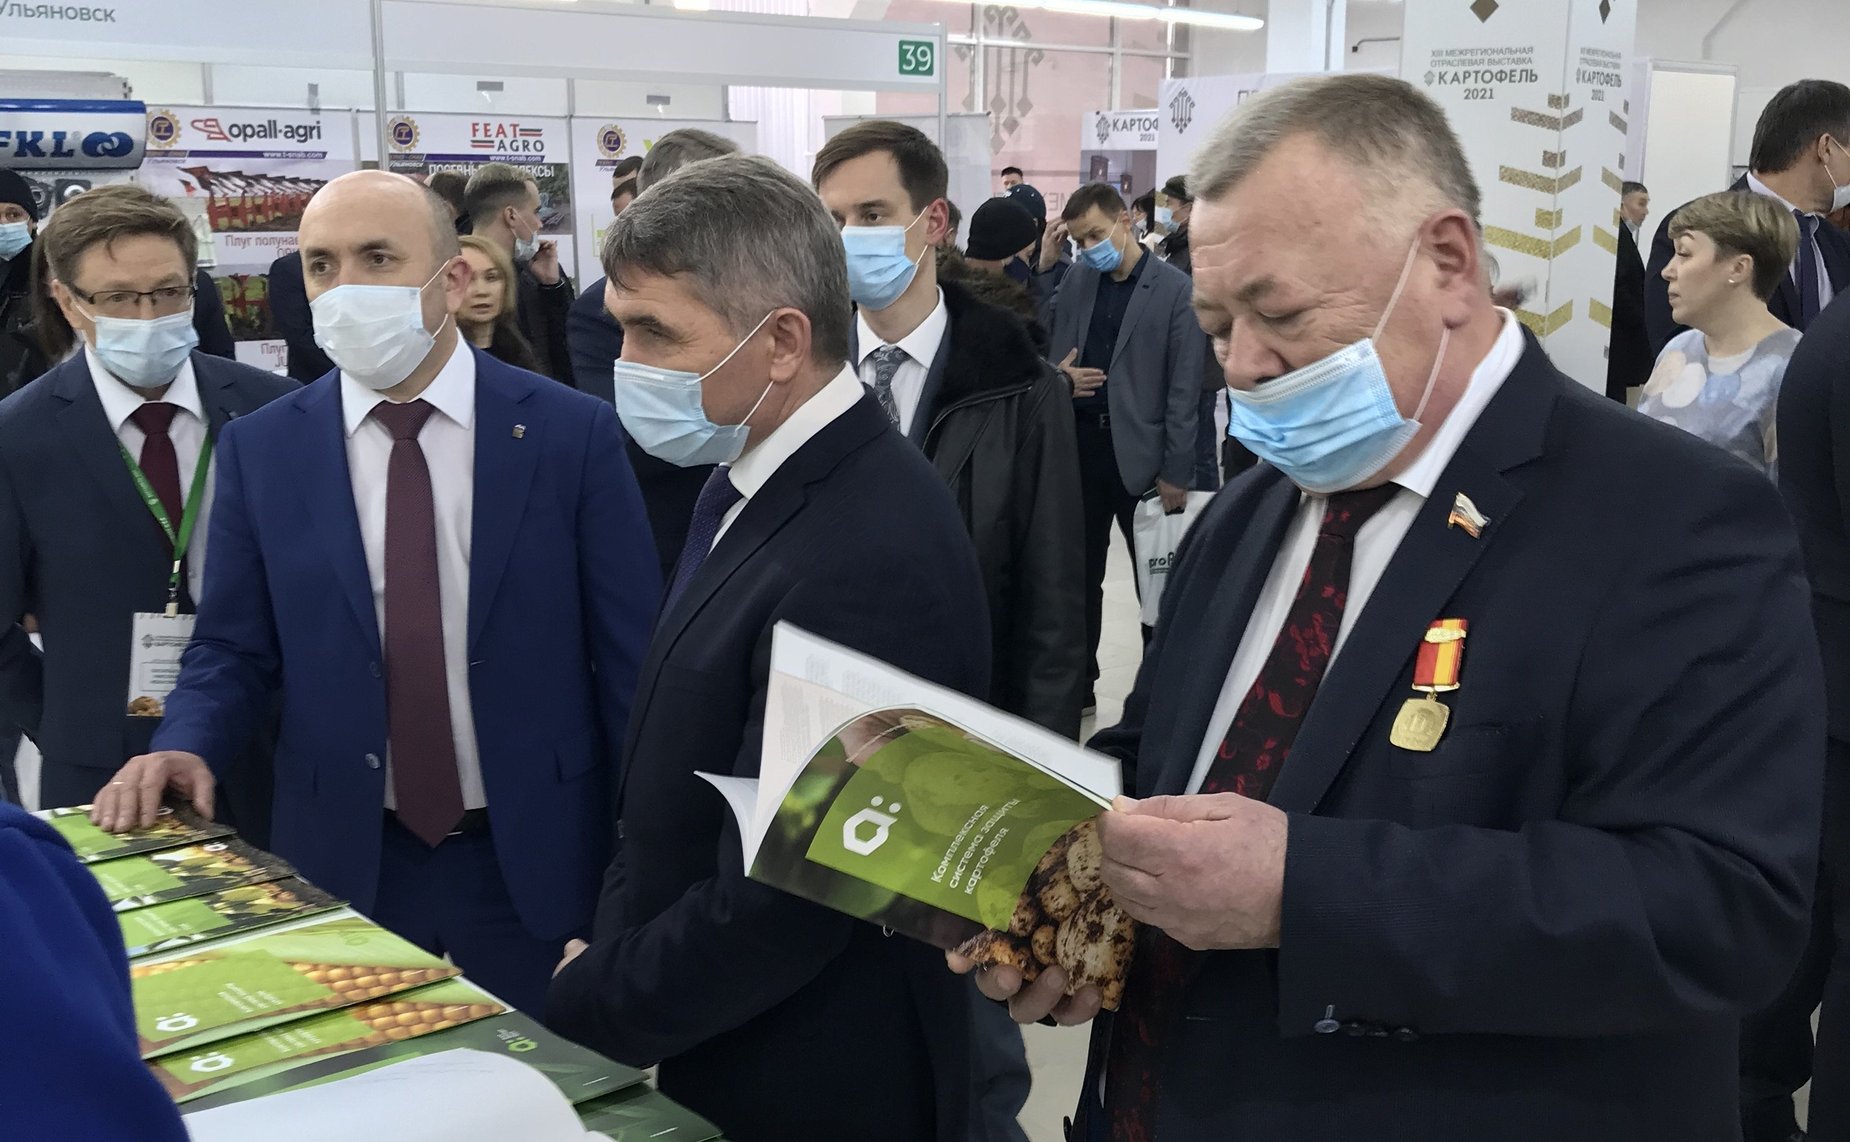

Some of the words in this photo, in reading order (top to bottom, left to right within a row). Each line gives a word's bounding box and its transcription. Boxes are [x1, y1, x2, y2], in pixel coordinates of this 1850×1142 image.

[902, 45, 932, 71] 39
[1445, 46, 1534, 58] МЕЖРЕГИОНАЛЬНАЯ
[1430, 59, 1485, 68] ОТРАСЛЕВАЯ
[1487, 57, 1533, 67] ВЫСТАВКА
[1438, 69, 1538, 85] КАРТОФЕЛЬ
[1463, 88, 1494, 100] 2021
[471, 123, 520, 138] FEAT
[497, 139, 545, 153] AGRO
[224, 235, 252, 249] Плуг
[930, 804, 989, 883] Комплексная
[949, 834, 985, 889] система
[980, 798, 1020, 834] защиты
[964, 827, 1010, 895] картофеля
